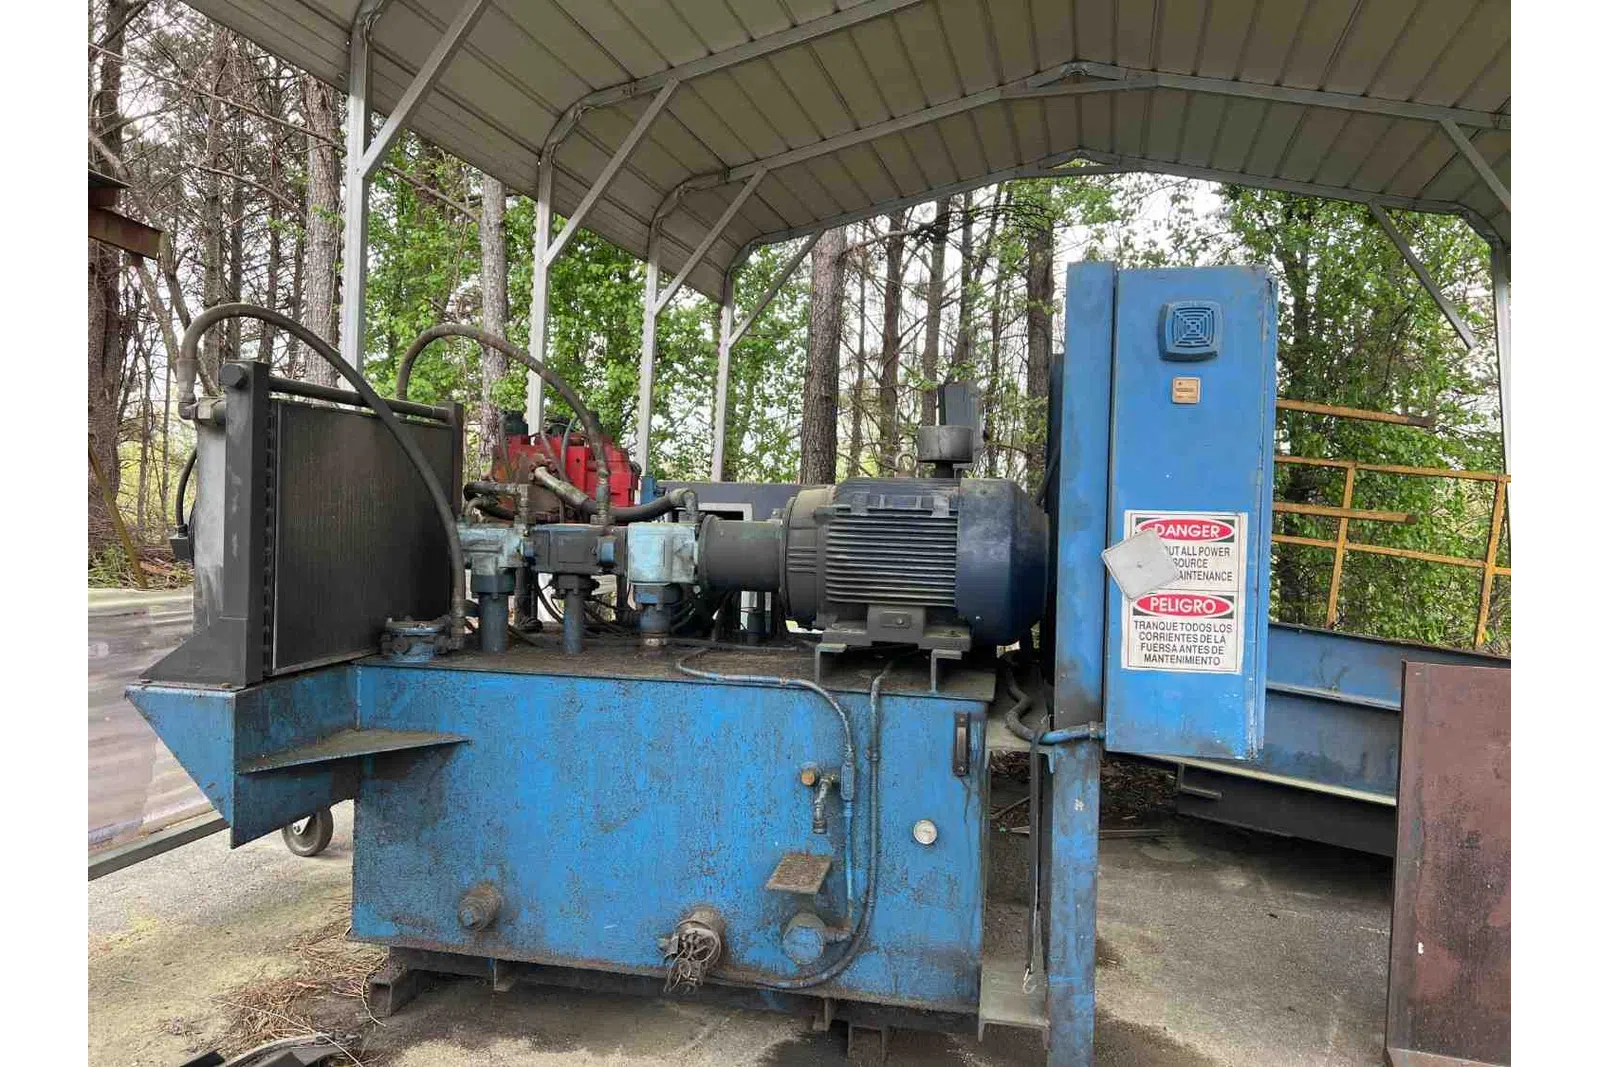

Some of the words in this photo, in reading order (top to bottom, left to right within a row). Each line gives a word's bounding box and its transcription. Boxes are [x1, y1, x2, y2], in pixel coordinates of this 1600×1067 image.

[1154, 523, 1220, 538] DANGER
[1165, 546, 1180, 556] UT
[1181, 546, 1197, 556] ALL
[1198, 547, 1230, 557] POWER
[1177, 570, 1233, 581] AINTENANCE
[1150, 598, 1217, 614] PELIGRO
[1134, 620, 1178, 631] TRANQUE
[1180, 622, 1212, 633] TODOS
[1213, 623, 1232, 633] LOS
[1139, 632, 1198, 643] CORRIENTES
[1200, 634, 1213, 644] DE
[1214, 635, 1226, 644] LA
[1141, 643, 1176, 653] FUERSA
[1179, 645, 1210, 654] ANTES
[1211, 646, 1224, 655] DE
[1144, 654, 1220, 666] MANTENIMIENTO
